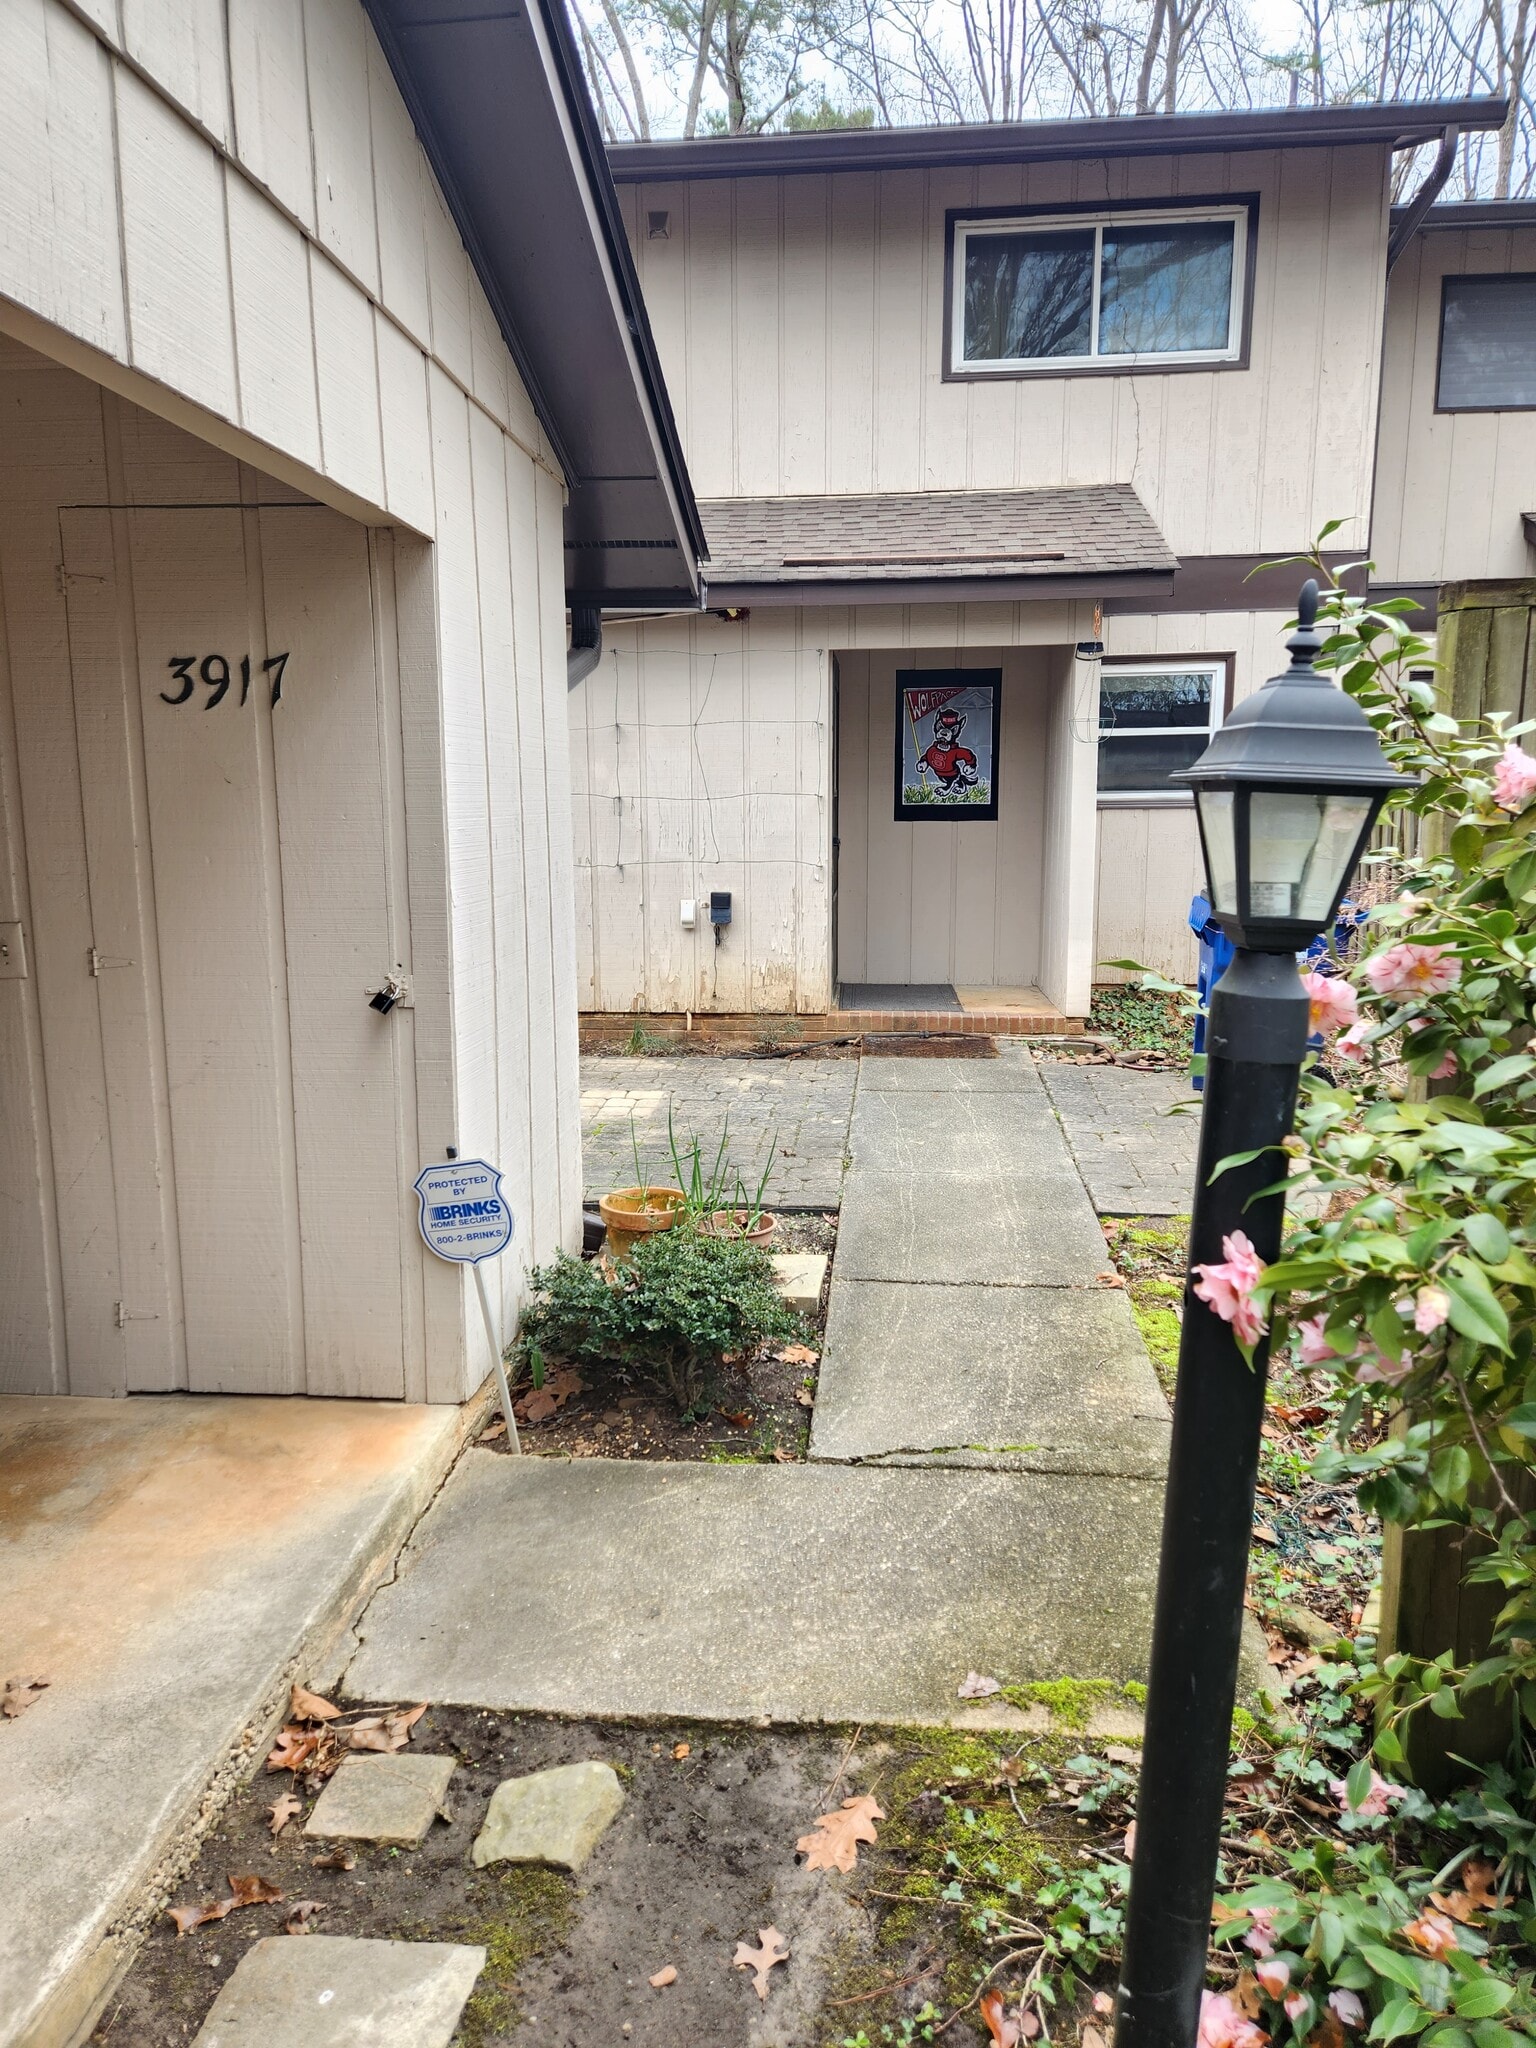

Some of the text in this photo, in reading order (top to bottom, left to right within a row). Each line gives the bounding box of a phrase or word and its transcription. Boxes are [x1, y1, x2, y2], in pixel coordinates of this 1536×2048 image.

[160, 652, 290, 711] 3917
[908, 690, 960, 719] WOLFPACK
[428, 1175, 488, 1190] PROTECTED
[453, 1188, 466, 1196] BY
[438, 1199, 501, 1220] BRINKS
[430, 1214, 502, 1229] HOME SECURITY
[436, 1229, 503, 1245] 800-2-BRINKS
